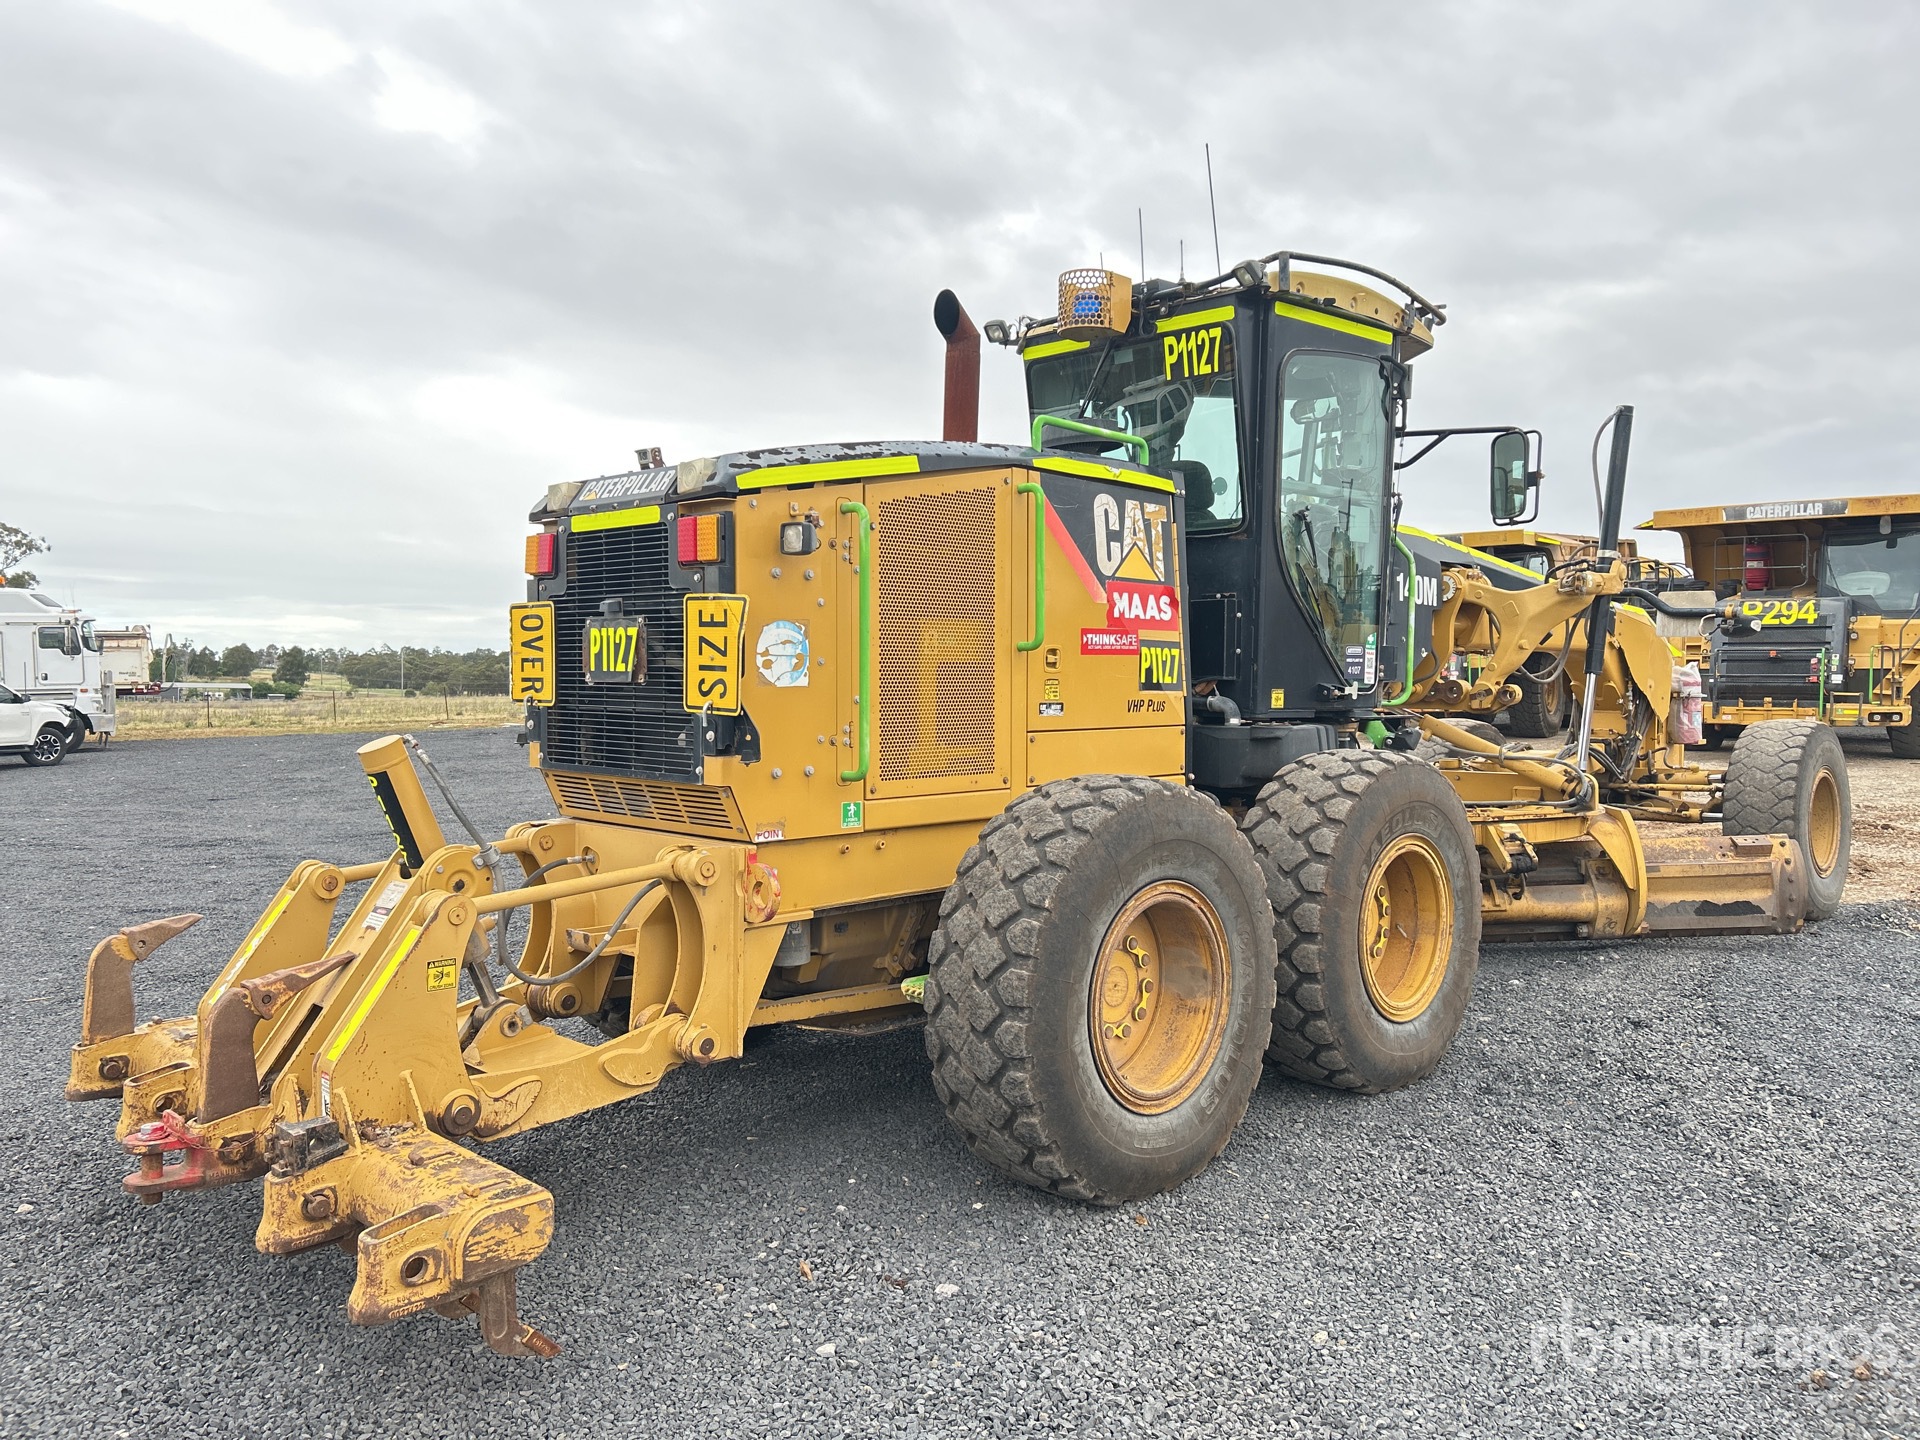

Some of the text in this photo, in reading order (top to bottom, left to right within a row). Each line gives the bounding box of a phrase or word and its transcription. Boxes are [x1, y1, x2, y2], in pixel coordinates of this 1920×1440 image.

[1164, 327, 1222, 380] P1127
[579, 470, 676, 500] CATERPILLAR
[1746, 502, 1823, 519] CATERPILLAR
[1094, 493, 1168, 581] CAT
[1113, 591, 1172, 621] MAAS
[1742, 600, 1818, 625] P294
[520, 613, 544, 694] OVER
[590, 627, 639, 672] P1127
[698, 607, 728, 699] SIZE
[1086, 633, 1138, 646] THINKSAFE
[1141, 646, 1180, 684] P1127
[1127, 699, 1145, 713] VHP
[434, 958, 456, 967] WARNING
